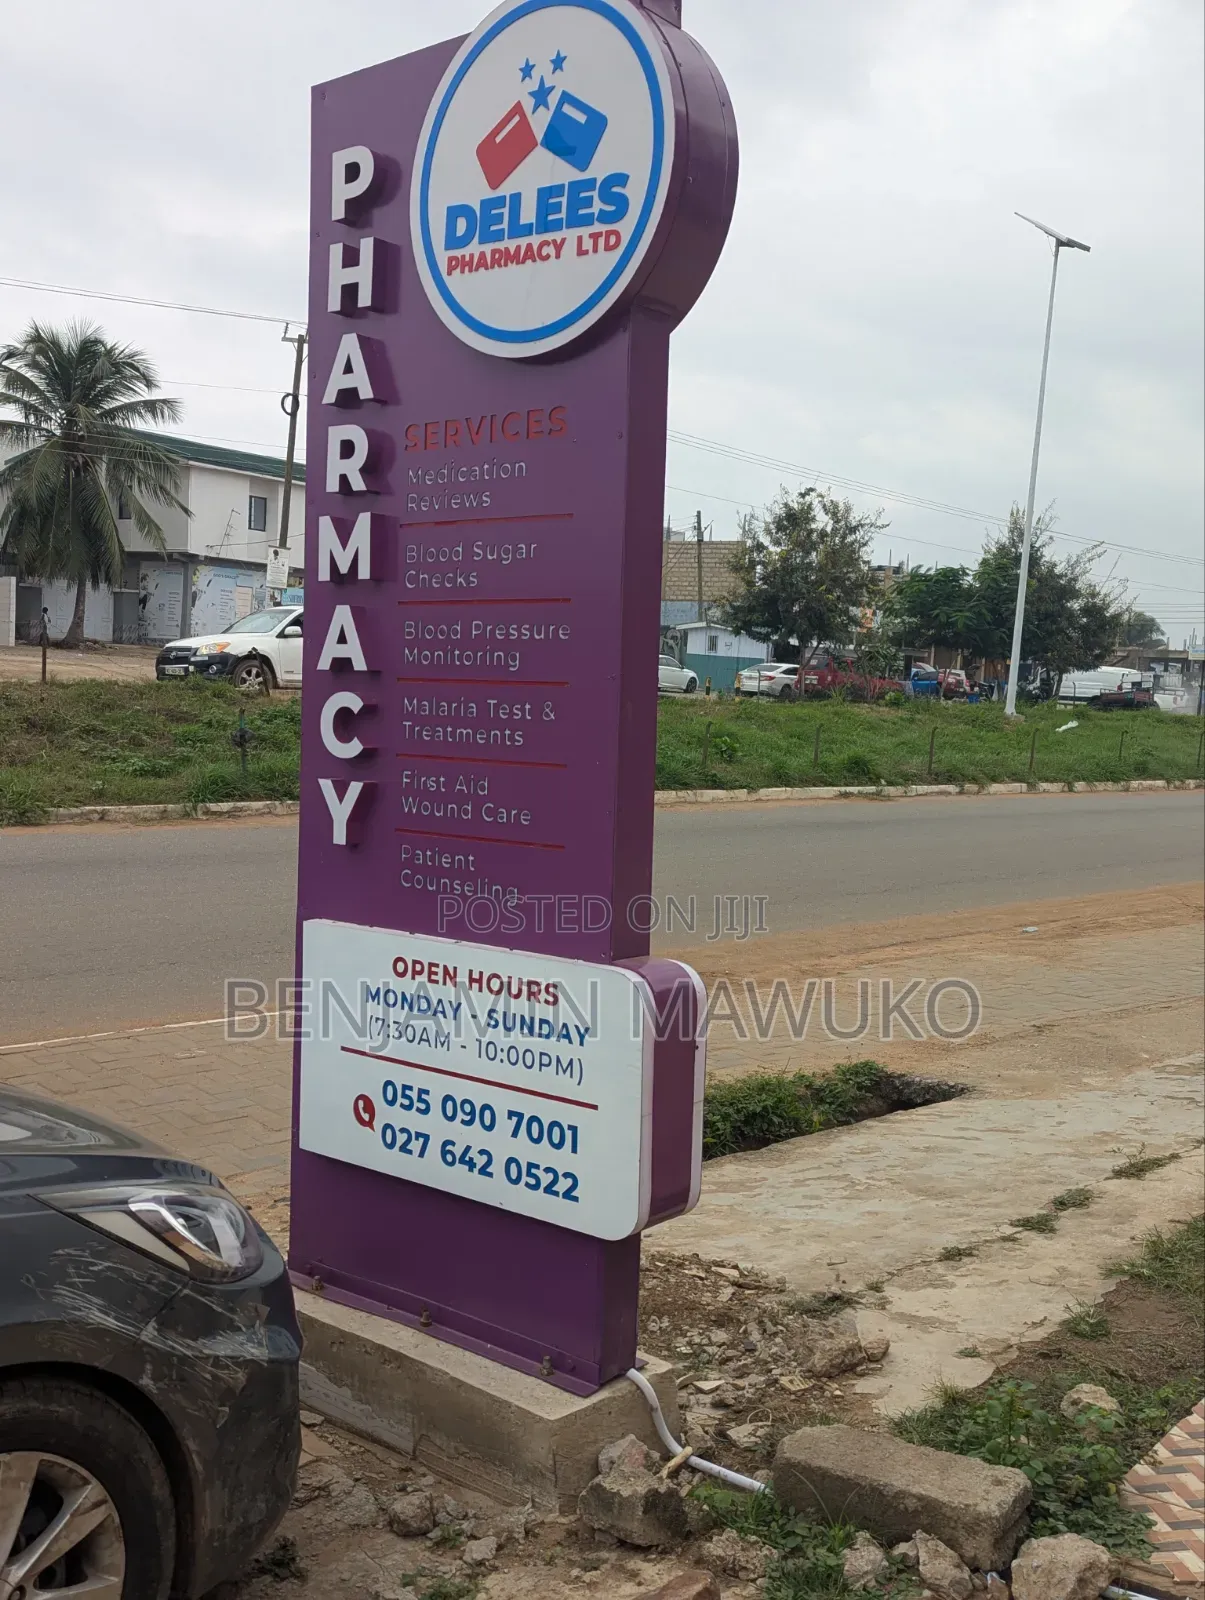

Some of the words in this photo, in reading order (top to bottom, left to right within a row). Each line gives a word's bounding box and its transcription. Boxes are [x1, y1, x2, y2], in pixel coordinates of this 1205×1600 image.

[444, 172, 631, 251] DELEES
[446, 237, 568, 277] PHARMACY
[576, 229, 622, 258] LTD
[404, 405, 568, 452] SERVICES
[407, 457, 527, 487] Medication
[316, 145, 375, 846] PHARMACY
[406, 489, 492, 513] Reviews
[406, 541, 464, 564] Blood
[472, 541, 538, 565] Sugar
[405, 567, 479, 589] Checks
[404, 620, 462, 640] Blood
[471, 620, 571, 640] Pressure
[404, 646, 521, 671] Monitoring
[403, 697, 478, 718] Malaria
[487, 699, 532, 720] Test
[542, 701, 556, 721] &
[402, 721, 525, 746] Treatments
[402, 770, 447, 793] First
[454, 774, 489, 796] Aid
[401, 795, 473, 820] Wound
[481, 802, 532, 825] Care
[401, 844, 476, 871] Patient
[400, 868, 519, 907] Counseling
[391, 956, 458, 989] OPEN
[467, 968, 560, 1007] HOURS
[365, 984, 463, 1021] MONDAY
[487, 1008, 591, 1047] SUNDAY
[368, 1014, 451, 1052] (7:30AM
[476, 1038, 584, 1086] 10:00PM)
[382, 1079, 432, 1116] 055
[441, 1094, 497, 1132] 090
[507, 1109, 579, 1154] 7001
[381, 1123, 431, 1159] 027
[440, 1139, 494, 1178] 642
[504, 1156, 580, 1203] 0522
